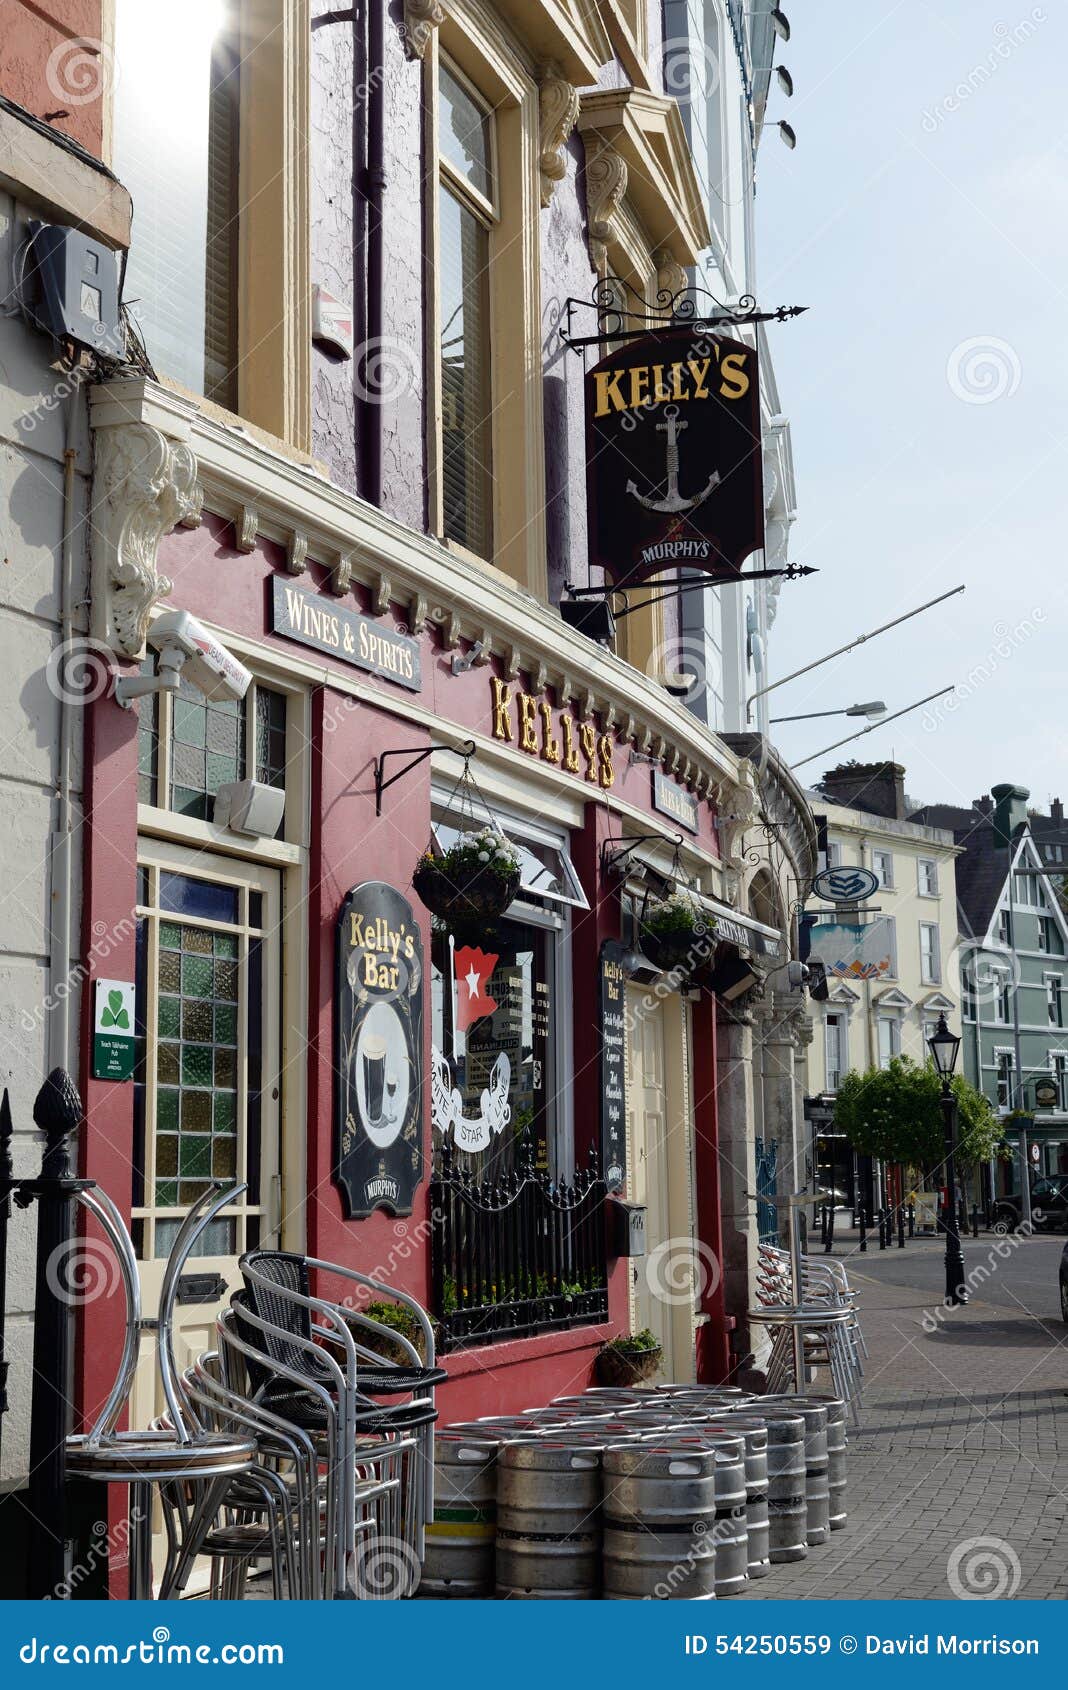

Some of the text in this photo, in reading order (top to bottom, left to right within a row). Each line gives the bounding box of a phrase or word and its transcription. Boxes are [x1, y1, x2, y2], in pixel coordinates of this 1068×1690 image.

[592, 344, 750, 418] KELLY'S
[285, 587, 413, 679] WINES & SPIRITS
[350, 912, 414, 991] Kelly's Bar
[604, 960, 623, 1000] Kelly's Bar
[461, 1125, 483, 1144] STAR
